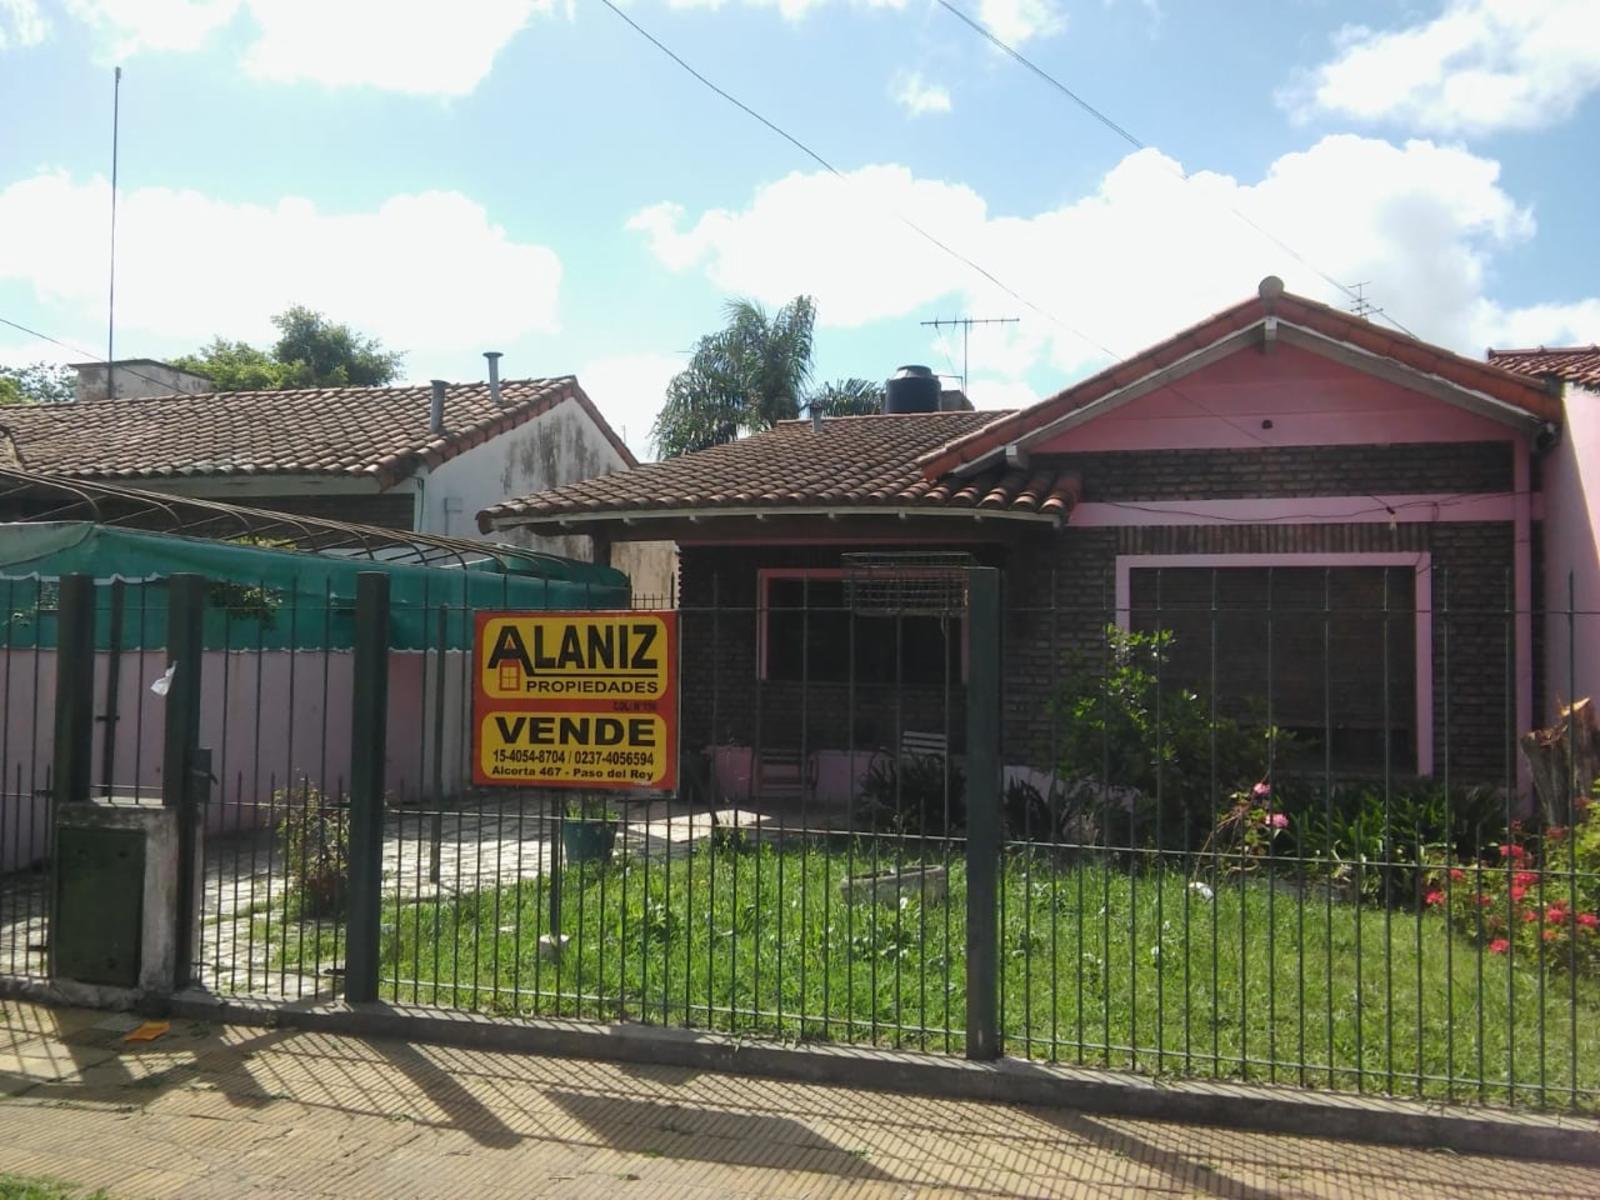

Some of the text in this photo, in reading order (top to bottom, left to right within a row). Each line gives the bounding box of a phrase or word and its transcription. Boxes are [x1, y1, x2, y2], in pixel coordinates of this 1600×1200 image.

[487, 625, 658, 676] ALANIZ
[526, 680, 658, 693] PROPIEDADES
[495, 717, 656, 747] VENDE
[493, 750, 566, 763] 15-4054-8704
[574, 751, 654, 766] 0237-4056594
[492, 767, 536, 776] Alcorta
[539, 768, 561, 777] 467
[573, 769, 603, 778] Paso
[607, 769, 627, 779] del
[630, 769, 654, 780] Rey
